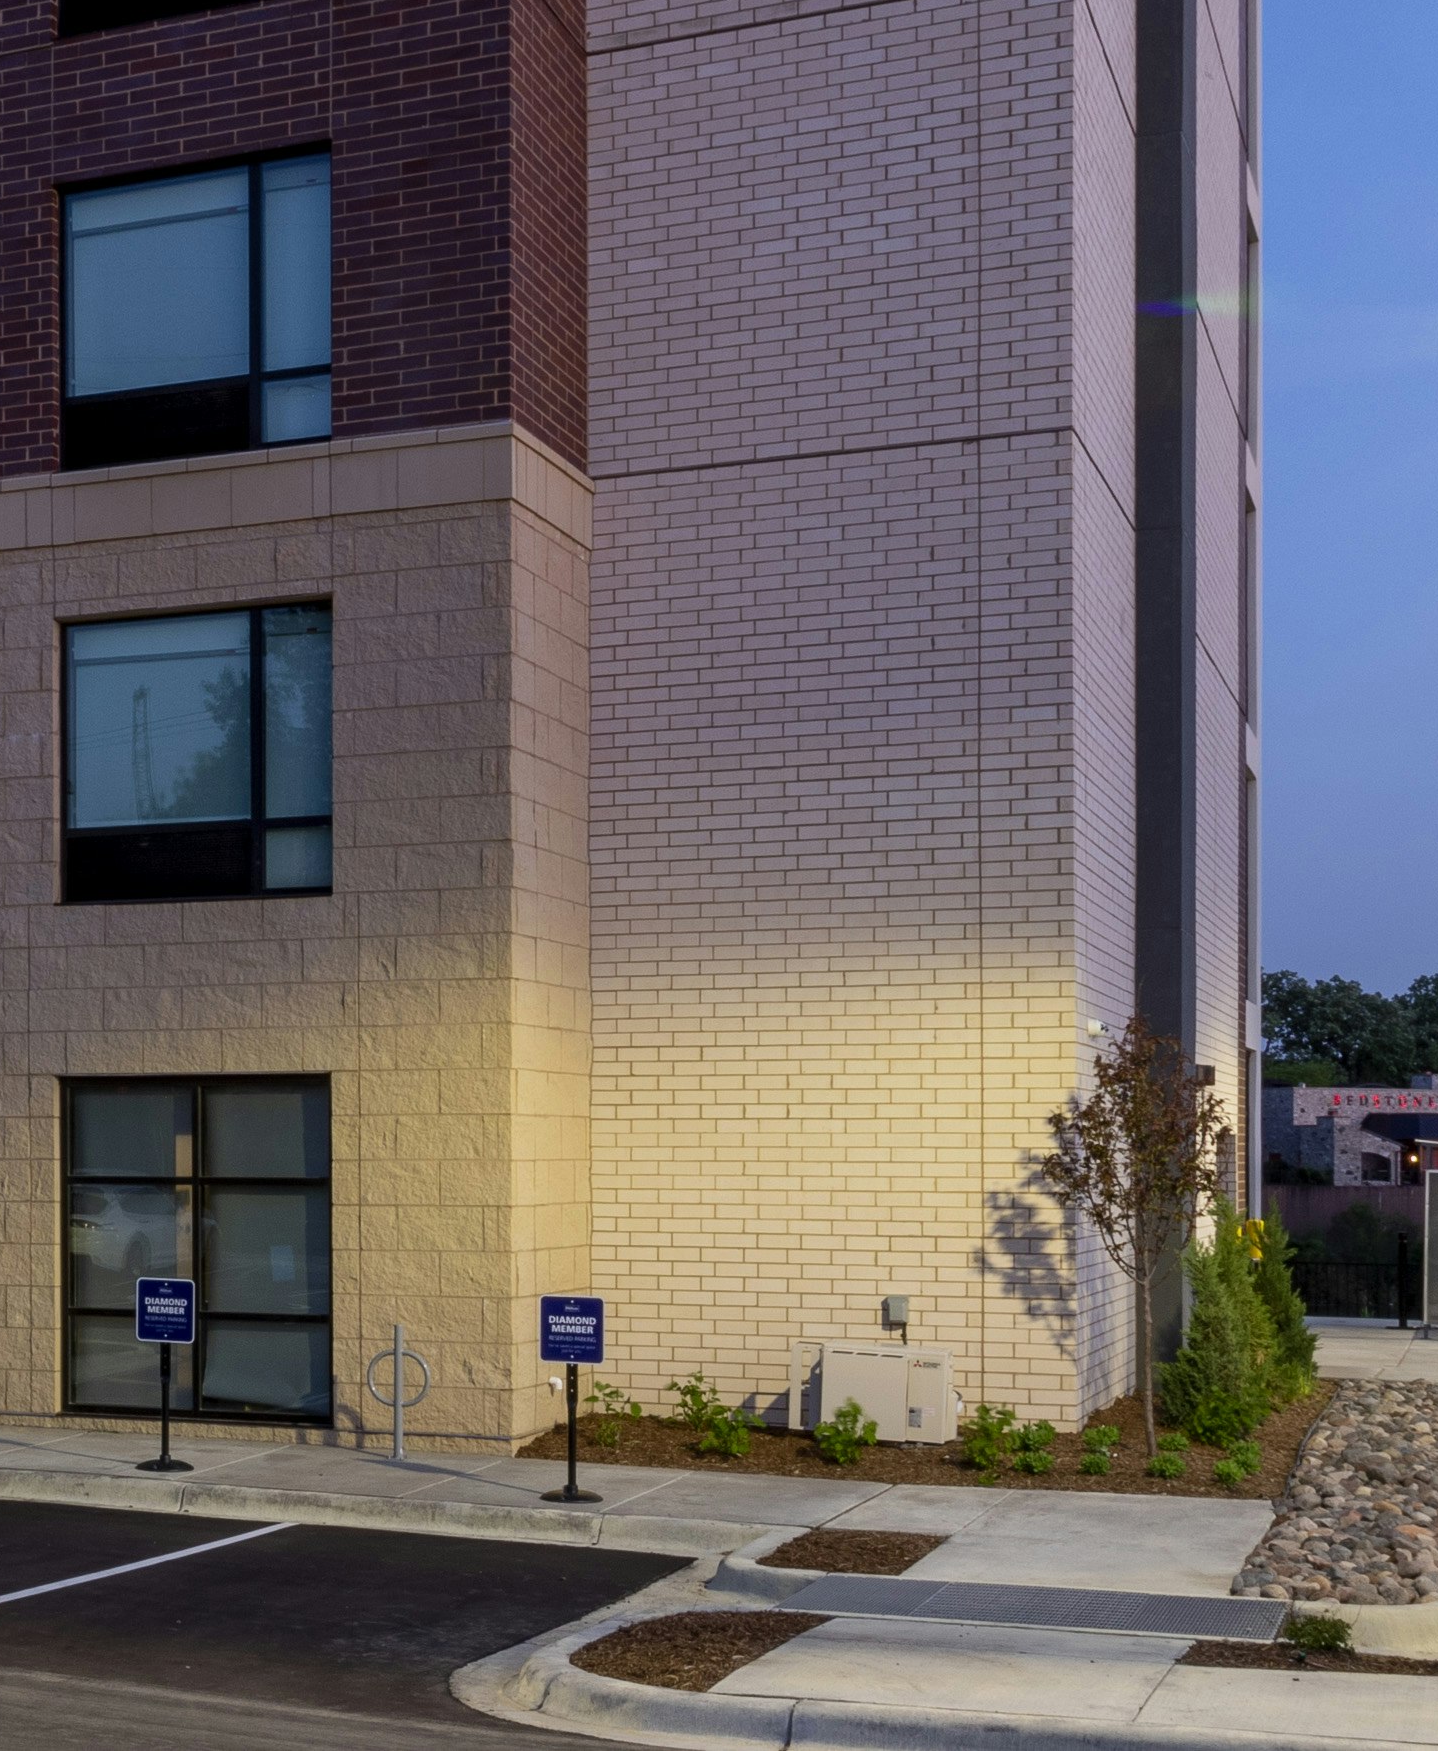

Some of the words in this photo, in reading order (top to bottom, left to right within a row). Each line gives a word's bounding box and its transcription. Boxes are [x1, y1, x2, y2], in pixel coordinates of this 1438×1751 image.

[144, 1297, 188, 1307] DIAMOND
[147, 1305, 185, 1315] MEMBER
[548, 1315, 597, 1326] DIAMOND
[551, 1325, 594, 1335] MEMBER
